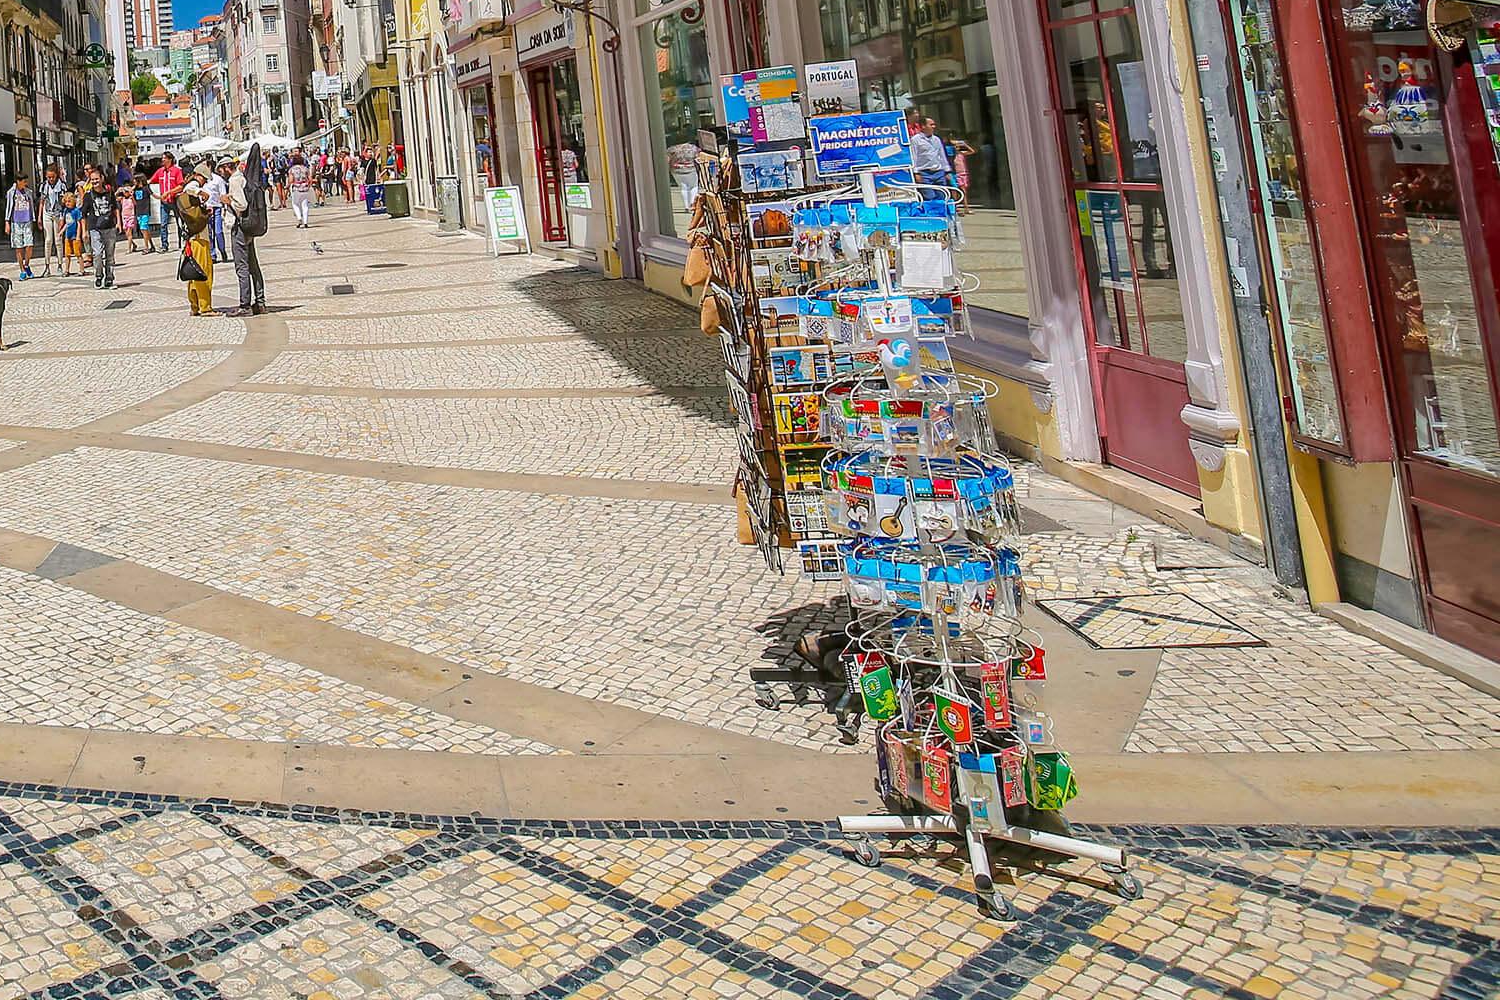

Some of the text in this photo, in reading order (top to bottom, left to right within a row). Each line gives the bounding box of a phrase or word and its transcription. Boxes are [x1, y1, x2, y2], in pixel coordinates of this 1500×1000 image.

[810, 70, 854, 83] PORTUGAL
[819, 125, 898, 140] MAGNÉTICOS
[820, 137, 899, 151] FRIDGE MAGNETS
